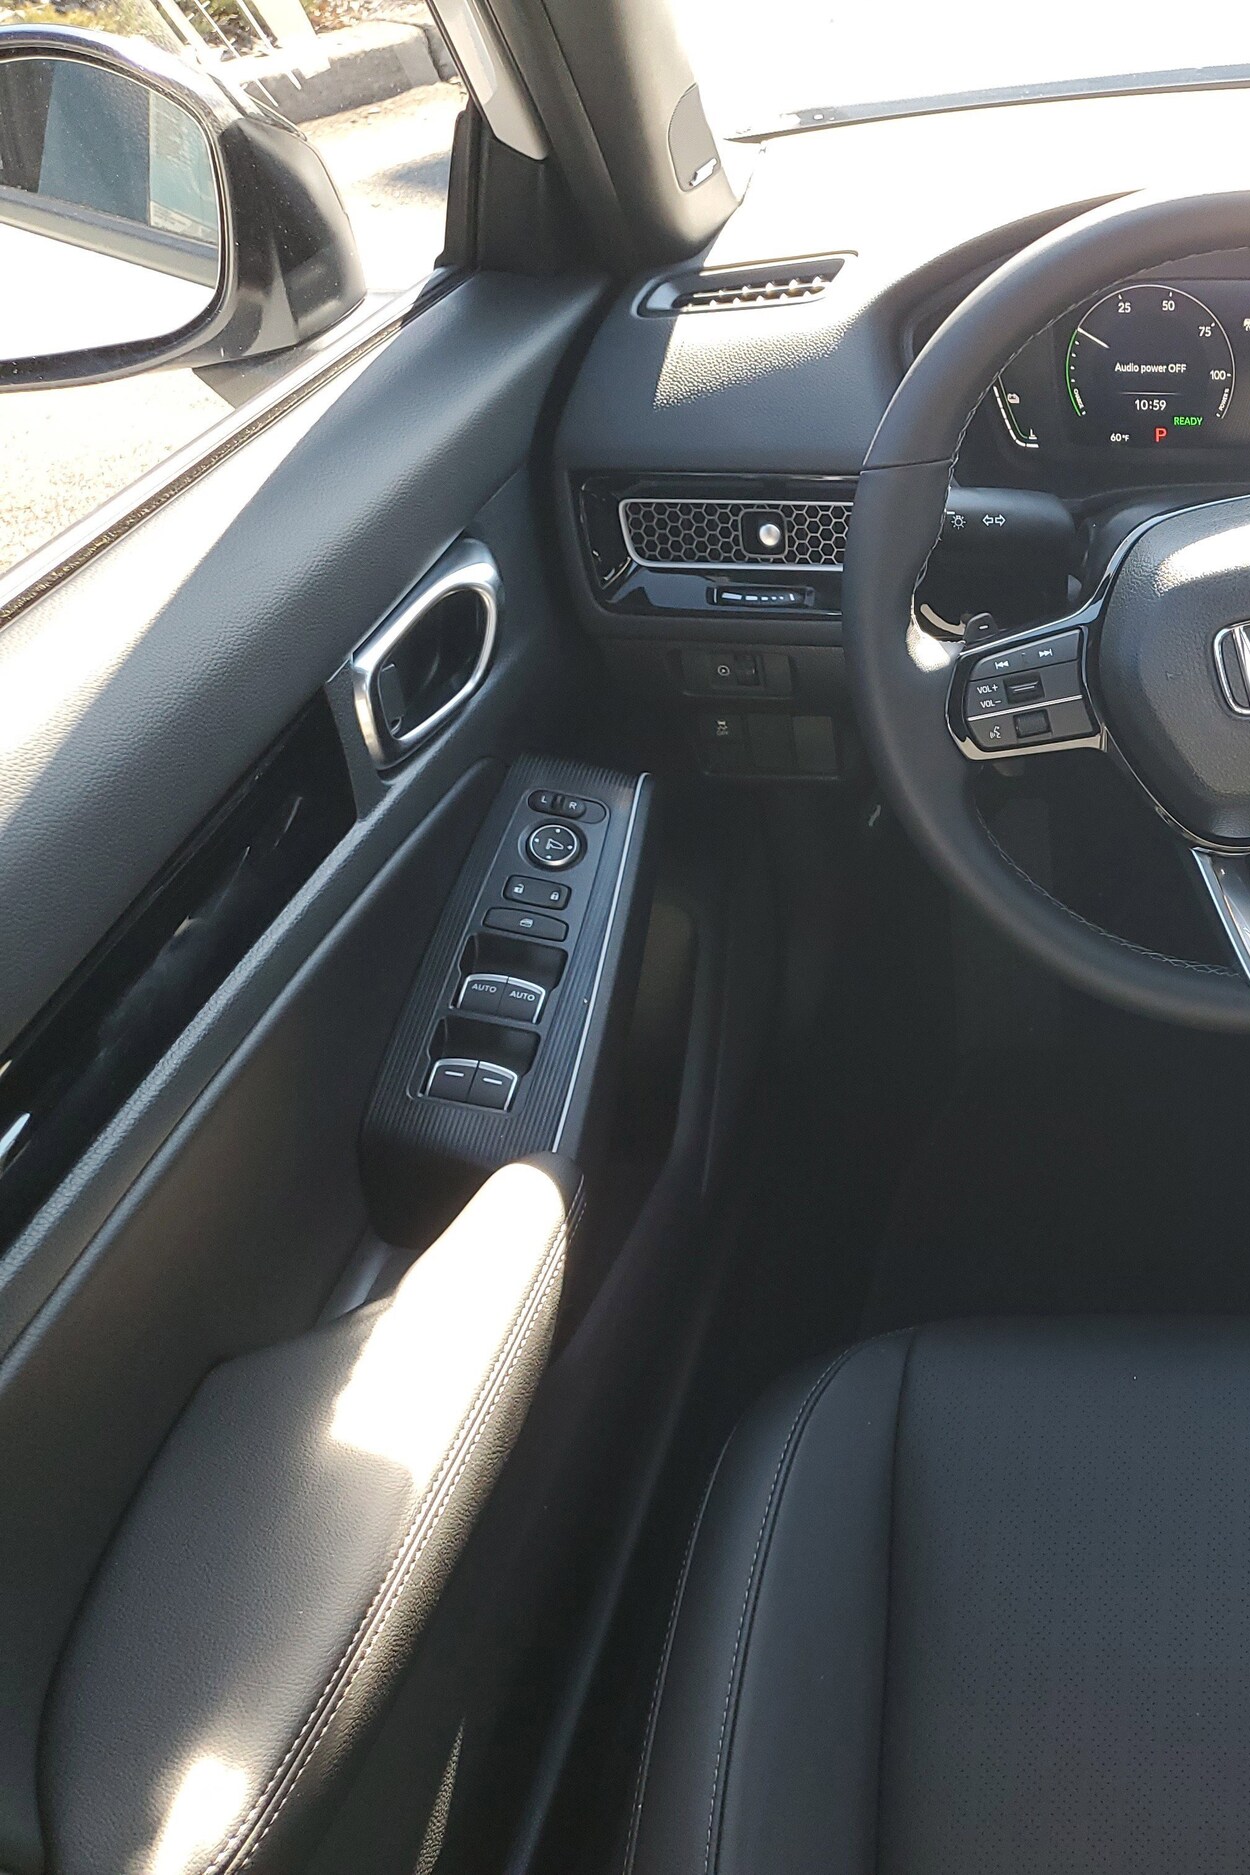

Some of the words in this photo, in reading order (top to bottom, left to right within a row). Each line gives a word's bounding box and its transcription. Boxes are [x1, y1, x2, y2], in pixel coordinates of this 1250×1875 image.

[1118, 302, 1131, 313] 25
[1162, 300, 1175, 312] 50
[1198, 326, 1212, 337] 75
[1114, 362, 1140, 373] Audio
[1140, 363, 1167, 374] power
[1168, 363, 1187, 373] OFF
[1209, 370, 1226, 380] 100
[1134, 399, 1167, 411] 10:59
[1173, 416, 1203, 426] READY
[1155, 427, 1168, 443] P
[540, 794, 548, 804] L
[568, 801, 578, 811] R
[471, 982, 497, 994] AUTO
[509, 990, 536, 1002] AUTO
